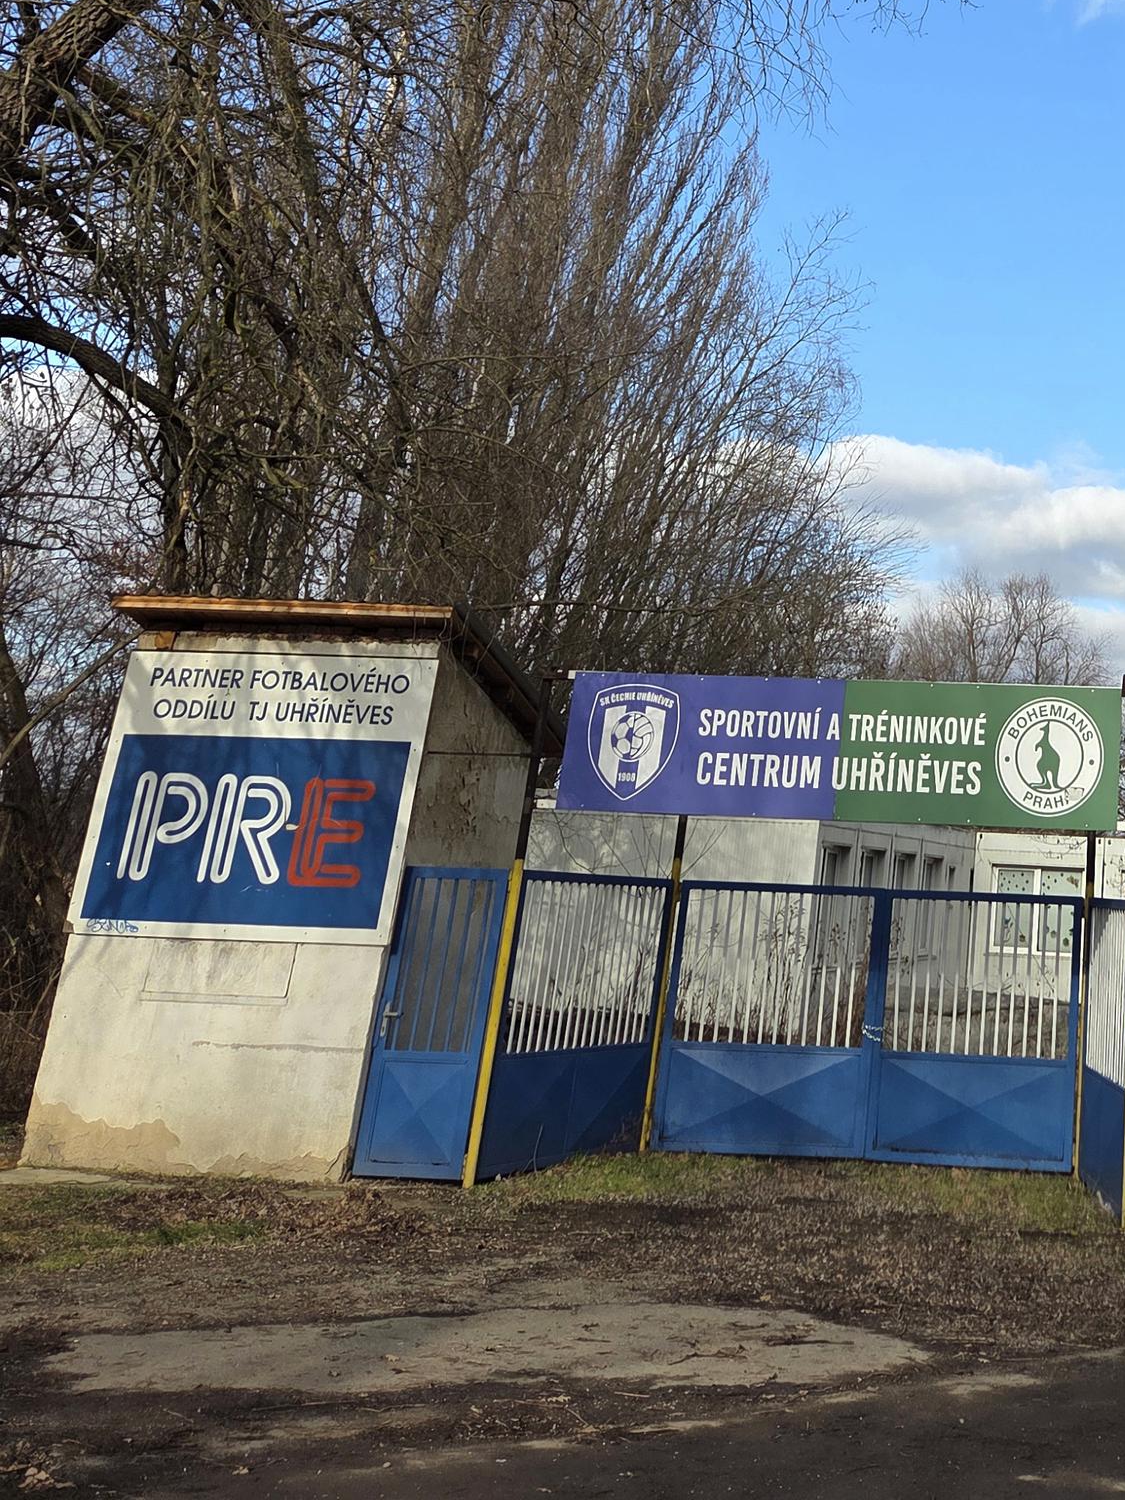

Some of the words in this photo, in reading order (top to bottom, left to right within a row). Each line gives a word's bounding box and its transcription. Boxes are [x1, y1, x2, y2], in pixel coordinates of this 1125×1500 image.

[150, 667, 244, 690] PARTNER
[250, 667, 410, 694] FOTBALOVÉHO
[153, 694, 235, 720] ODDÍLU
[249, 701, 267, 721] TJ
[275, 697, 393, 725] UHŘÍNĚVES
[699, 707, 822, 740] SPORTOVNÍ
[826, 713, 840, 741] A
[849, 709, 987, 746] TRÉNINKOVÉ
[1008, 704, 1093, 742] BOHEMIANS
[696, 752, 822, 789] CENTRUM
[831, 751, 982, 795] UHŘÍNĚVES
[116, 771, 377, 887] PRE
